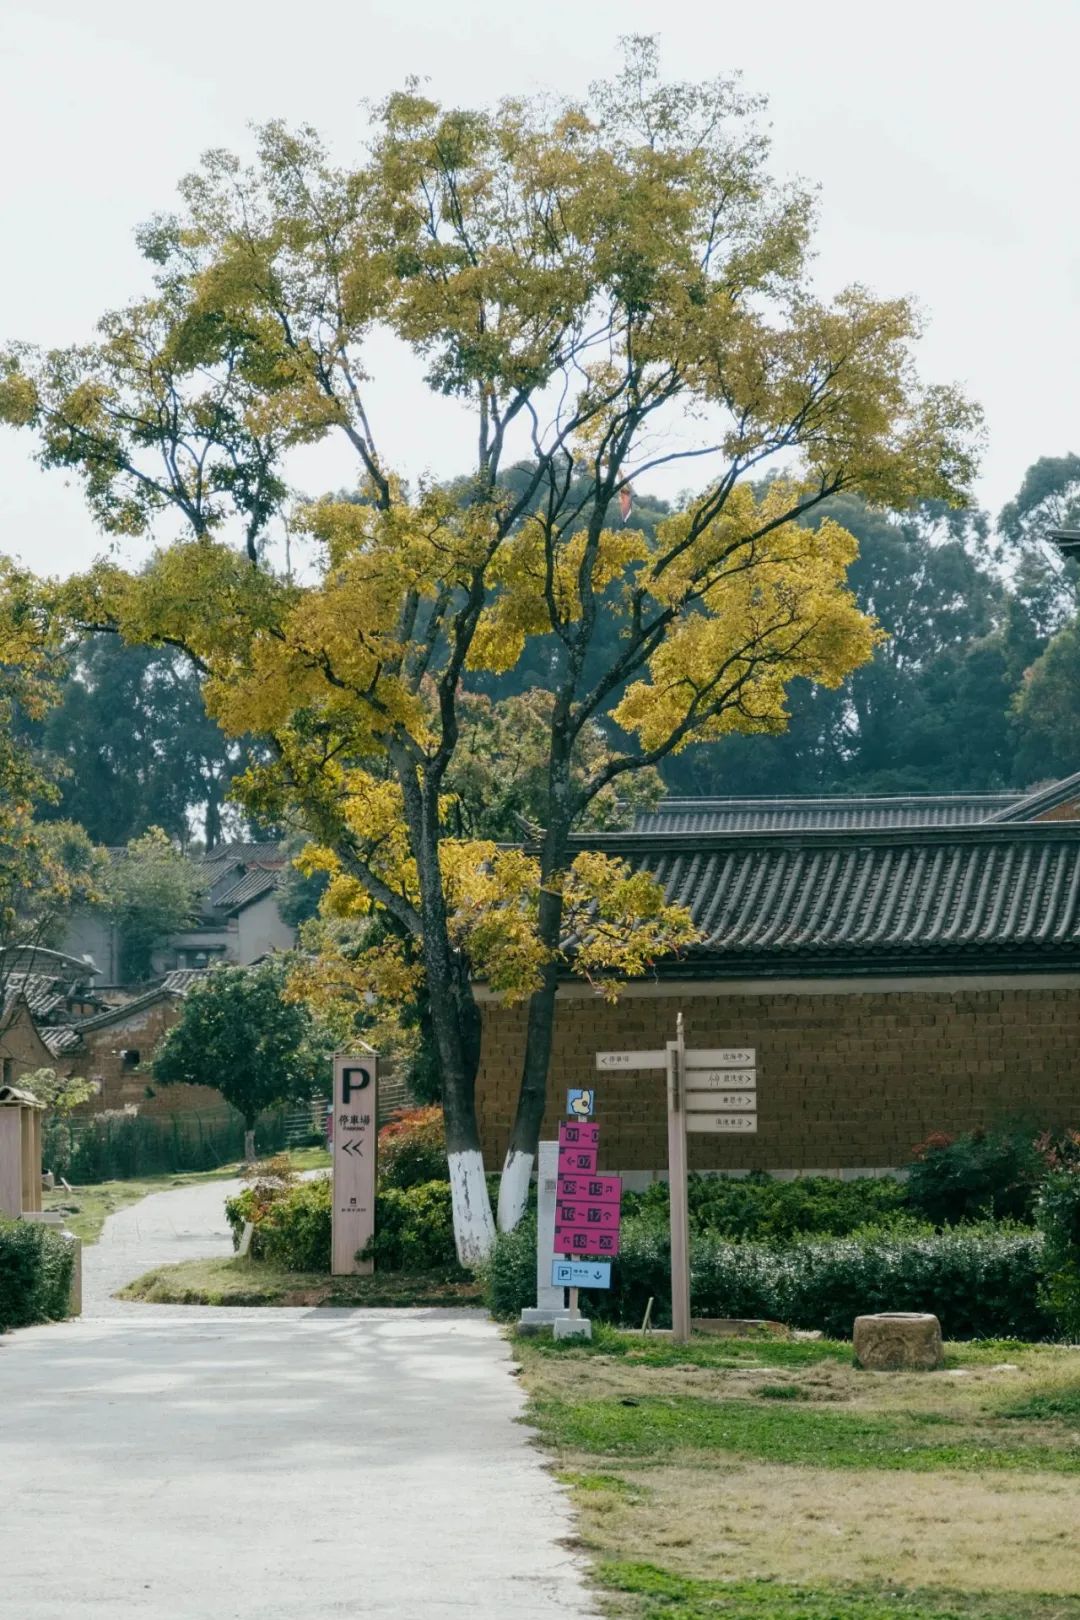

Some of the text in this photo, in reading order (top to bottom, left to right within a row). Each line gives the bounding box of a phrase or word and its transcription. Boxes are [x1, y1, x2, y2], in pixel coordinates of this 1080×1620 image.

[342, 1068, 370, 1105] P
[566, 1129, 578, 1140] 01
[578, 1156, 590, 1168] 07
[590, 1183, 602, 1195] 15
[588, 1209, 600, 1221] 17
[574, 1235, 587, 1247] 18
[600, 1237, 612, 1248] 20
[561, 1269, 569, 1277] P
